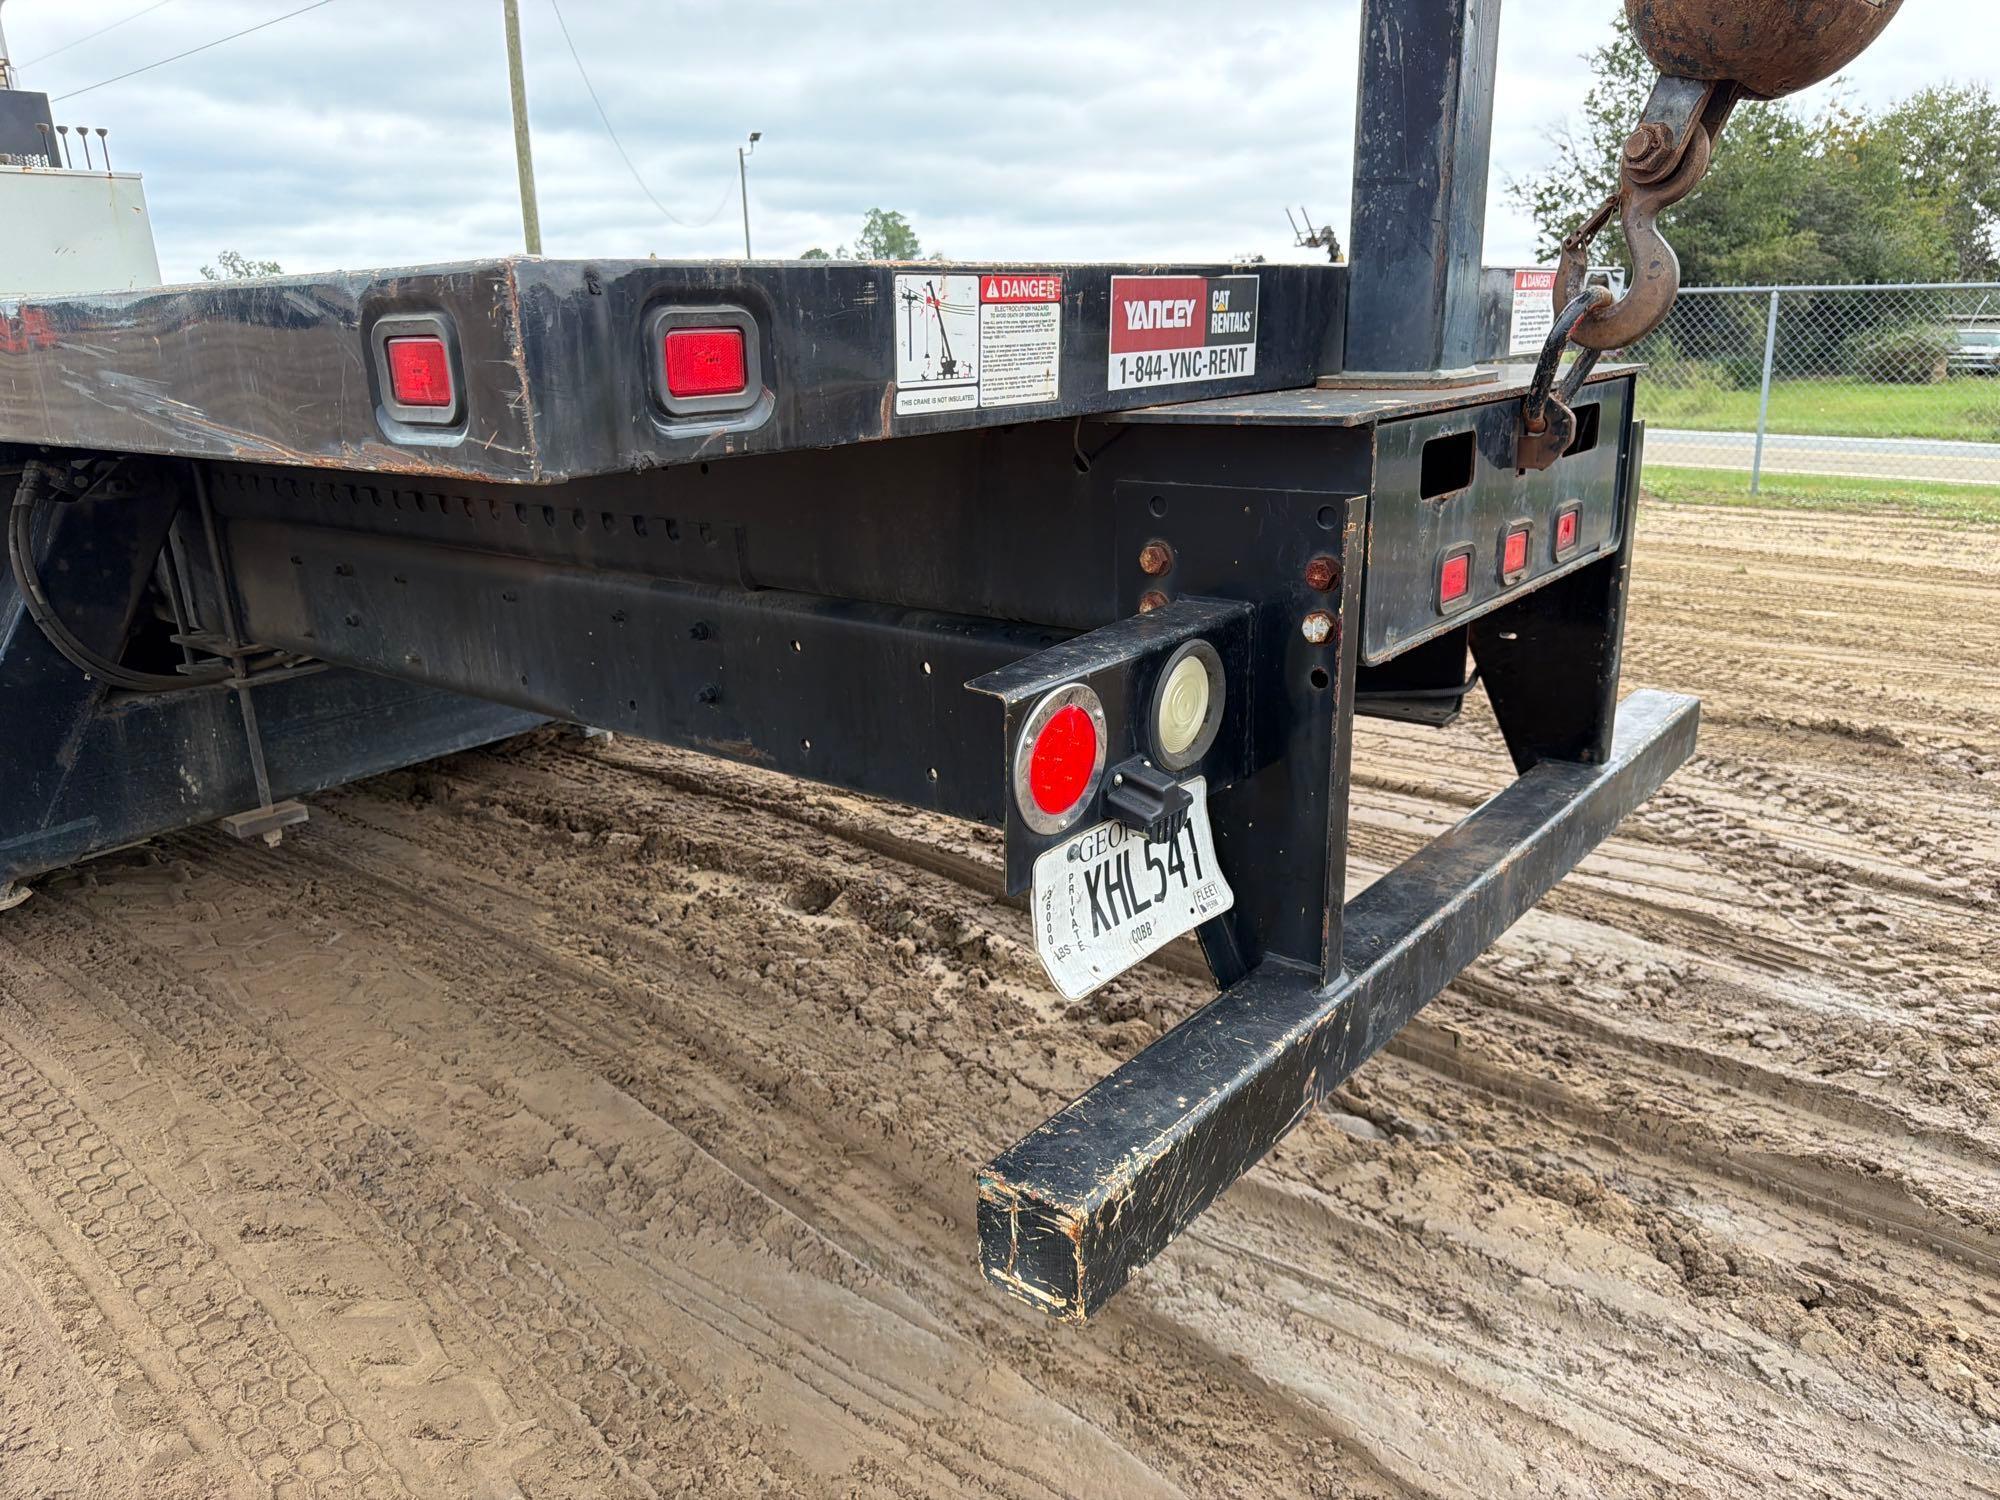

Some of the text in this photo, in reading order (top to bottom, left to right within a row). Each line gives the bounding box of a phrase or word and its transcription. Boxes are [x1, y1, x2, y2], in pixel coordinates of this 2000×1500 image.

[1001, 280, 1055, 298] DANGER
[1528, 274, 1551, 288] DANGER
[1212, 290, 1230, 312] CAT
[1123, 298, 1197, 330] YANCEY
[1211, 311, 1250, 334] RENTALS
[1119, 347, 1248, 384] 1-844-YNC-RENT
[914, 398, 930, 406] CRANE
[1083, 818, 1203, 938] XHL541
[1196, 884, 1218, 903] FLEET
[1068, 873, 1085, 952] PRIVATE
[1131, 921, 1153, 944] COBB
[1055, 944, 1072, 962] LBS
